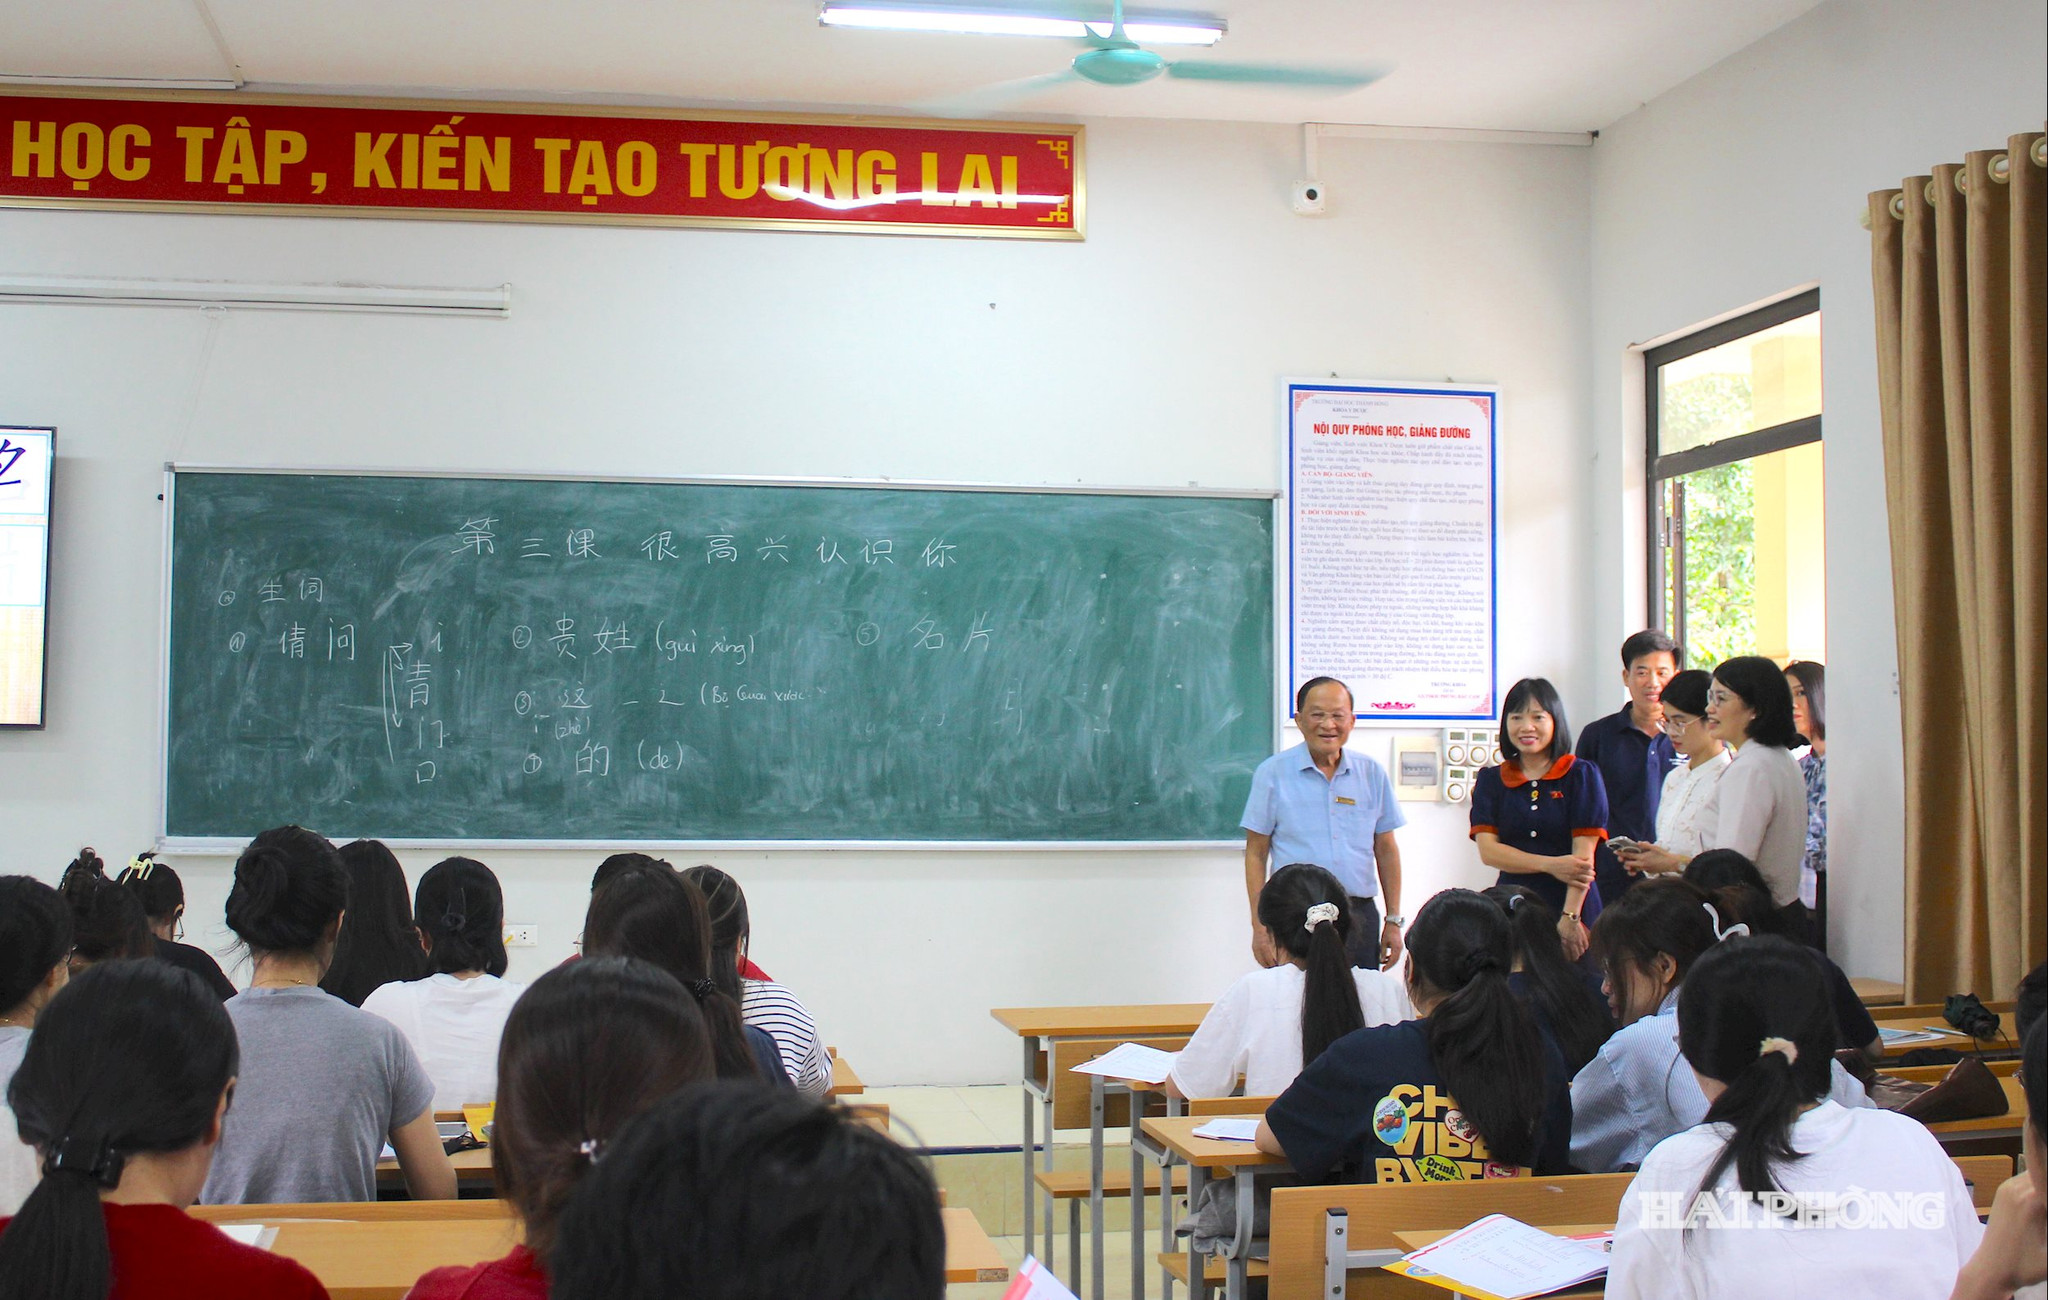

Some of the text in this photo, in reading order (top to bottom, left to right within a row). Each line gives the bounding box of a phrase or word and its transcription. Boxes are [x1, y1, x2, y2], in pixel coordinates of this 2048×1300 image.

[12, 115, 1018, 209] HỌC TẬP, KIẾN TẠO TƯƠNG LAI
[1313, 421, 1471, 439] NỘI QUY PHÒNG HỌC, GIẢNG ĐƯỜNG
[549, 611, 637, 659] 贵姓
[908, 609, 994, 653] 名片
[575, 738, 610, 777] 的
[1426, 1156, 1457, 1177] Drink
